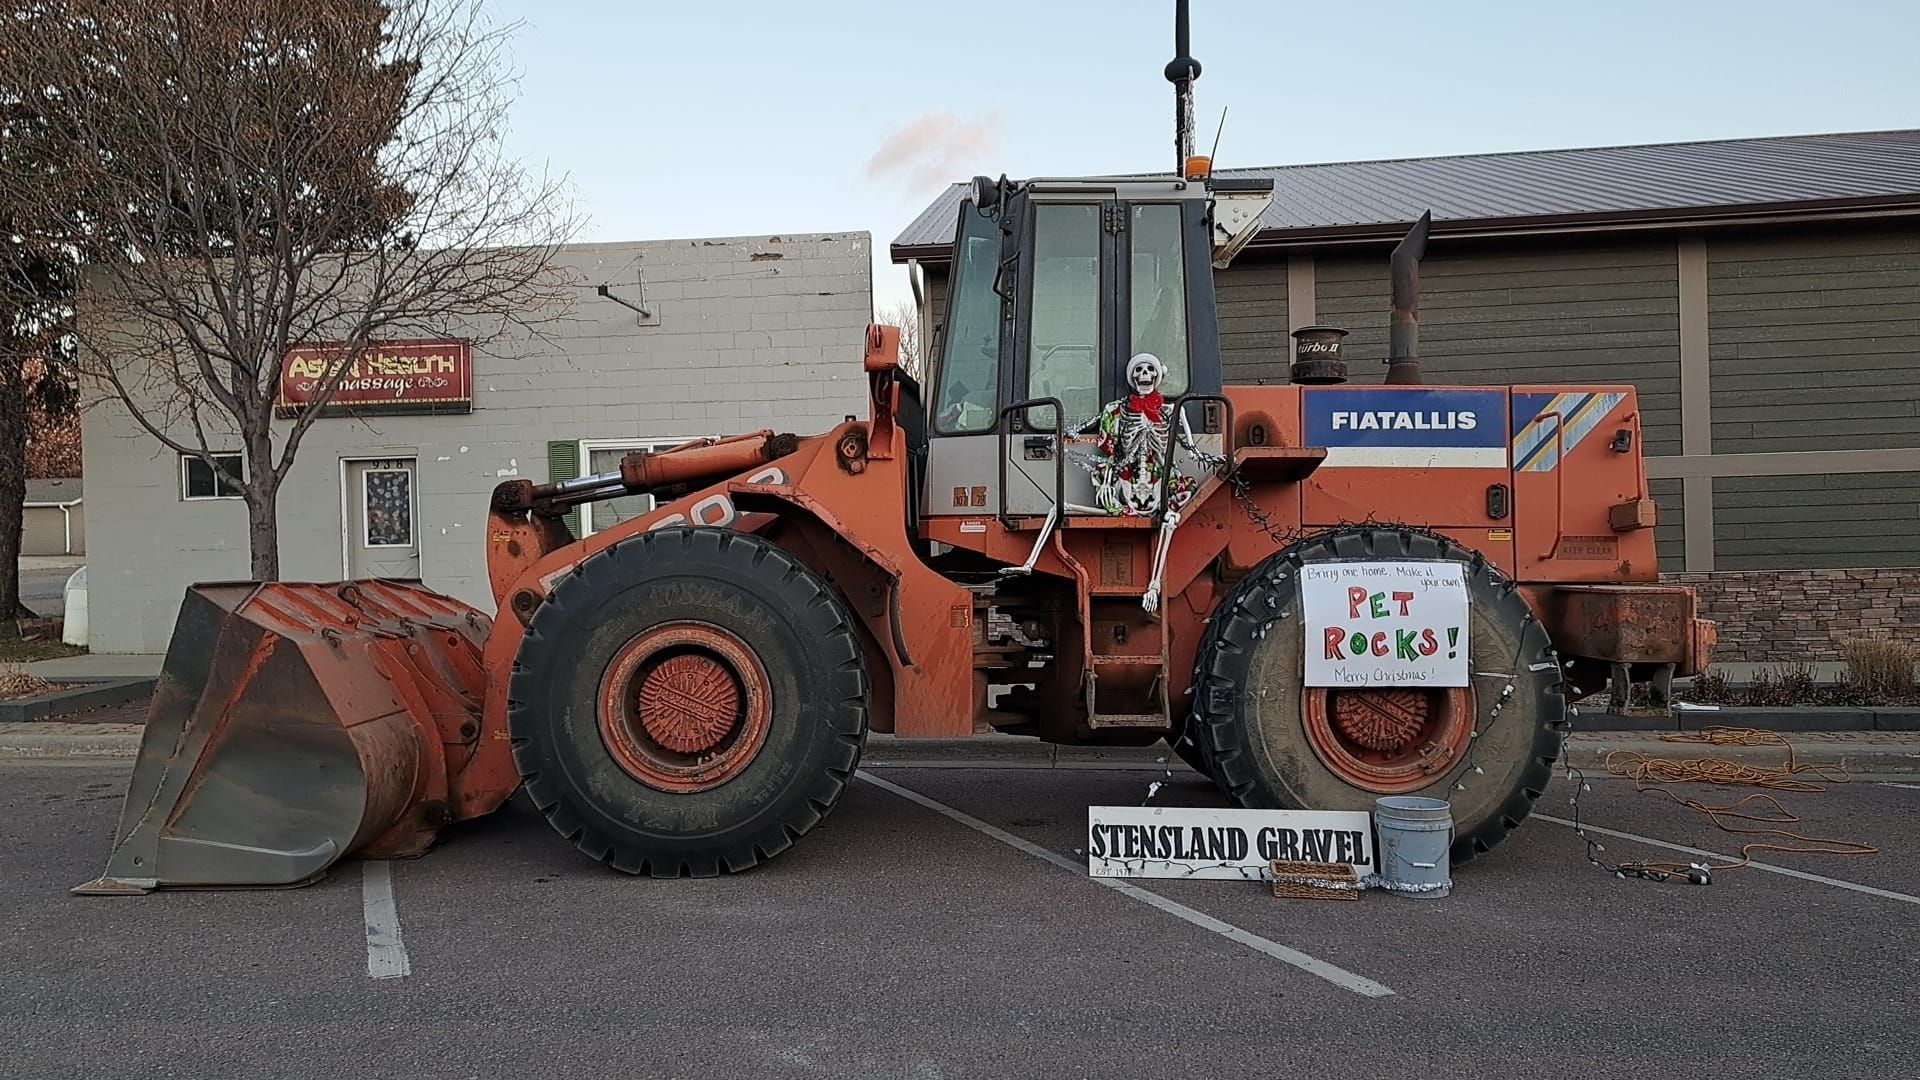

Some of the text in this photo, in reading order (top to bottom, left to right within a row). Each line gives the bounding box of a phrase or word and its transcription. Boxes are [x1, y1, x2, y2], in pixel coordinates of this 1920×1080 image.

[365, 353, 454, 375] HEALTH
[1332, 411, 1477, 430] FIATALLIS
[372, 459, 403, 469] 938
[1306, 567, 1339, 583] Bring
[1342, 569, 1358, 577] one
[1396, 567, 1423, 577] Make
[1425, 566, 1434, 577] it
[1420, 577, 1440, 592] your
[1348, 586, 1414, 619] PET
[1334, 668, 1369, 682] Merry
[1091, 823, 1249, 861] STENSLAND
[1256, 826, 1371, 866] GRAVEL
